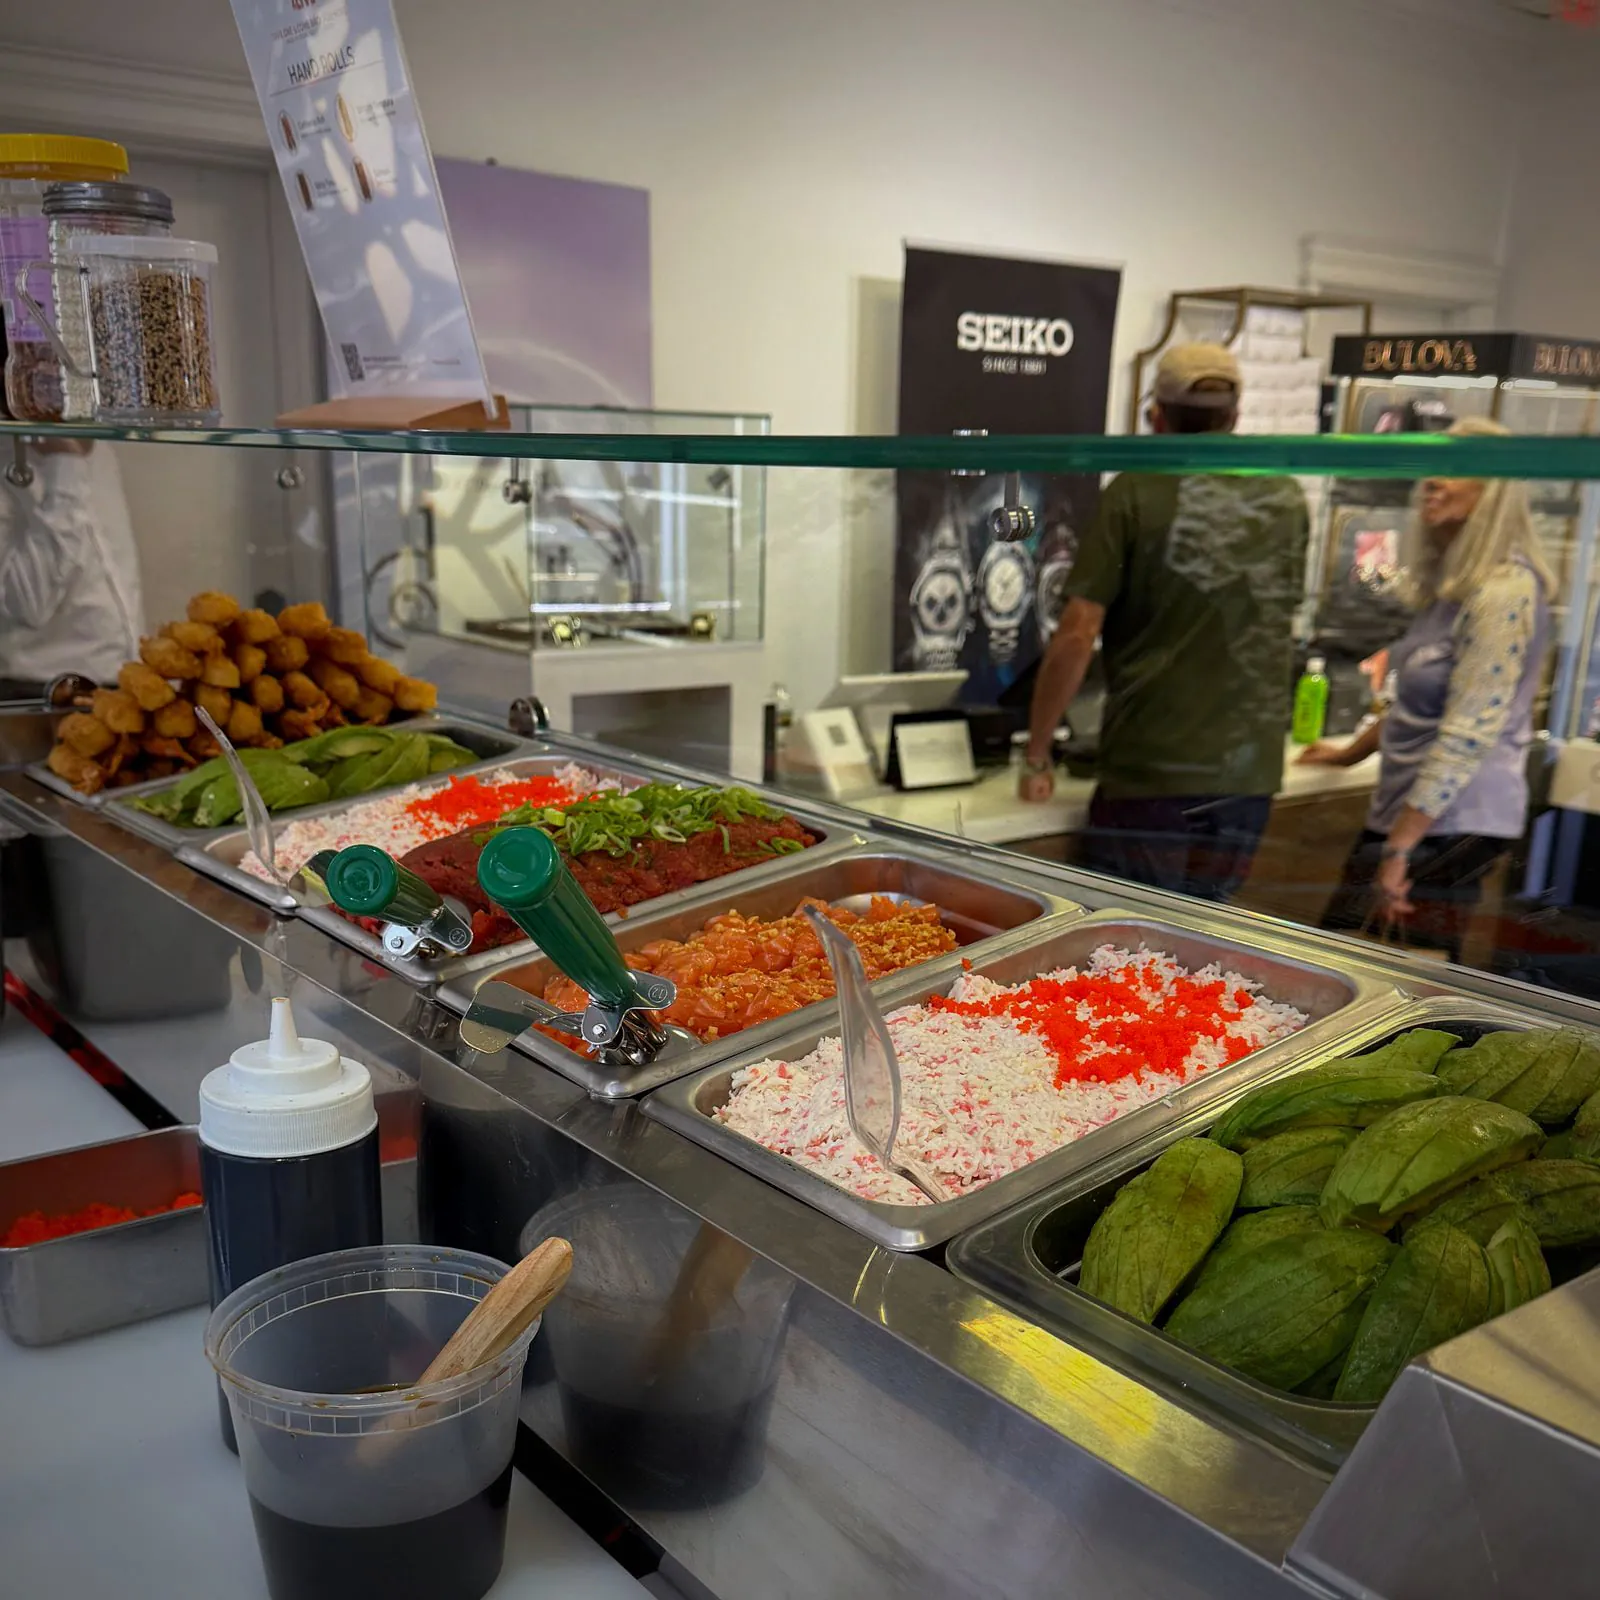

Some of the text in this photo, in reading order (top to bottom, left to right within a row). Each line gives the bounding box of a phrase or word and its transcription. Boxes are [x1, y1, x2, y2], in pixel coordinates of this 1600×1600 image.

[287, 46, 355, 85] HAND ROLLS
[957, 311, 1074, 357] SEIKO
[982, 356, 1017, 374] SINCE
[1362, 338, 1478, 372] BULOVA
